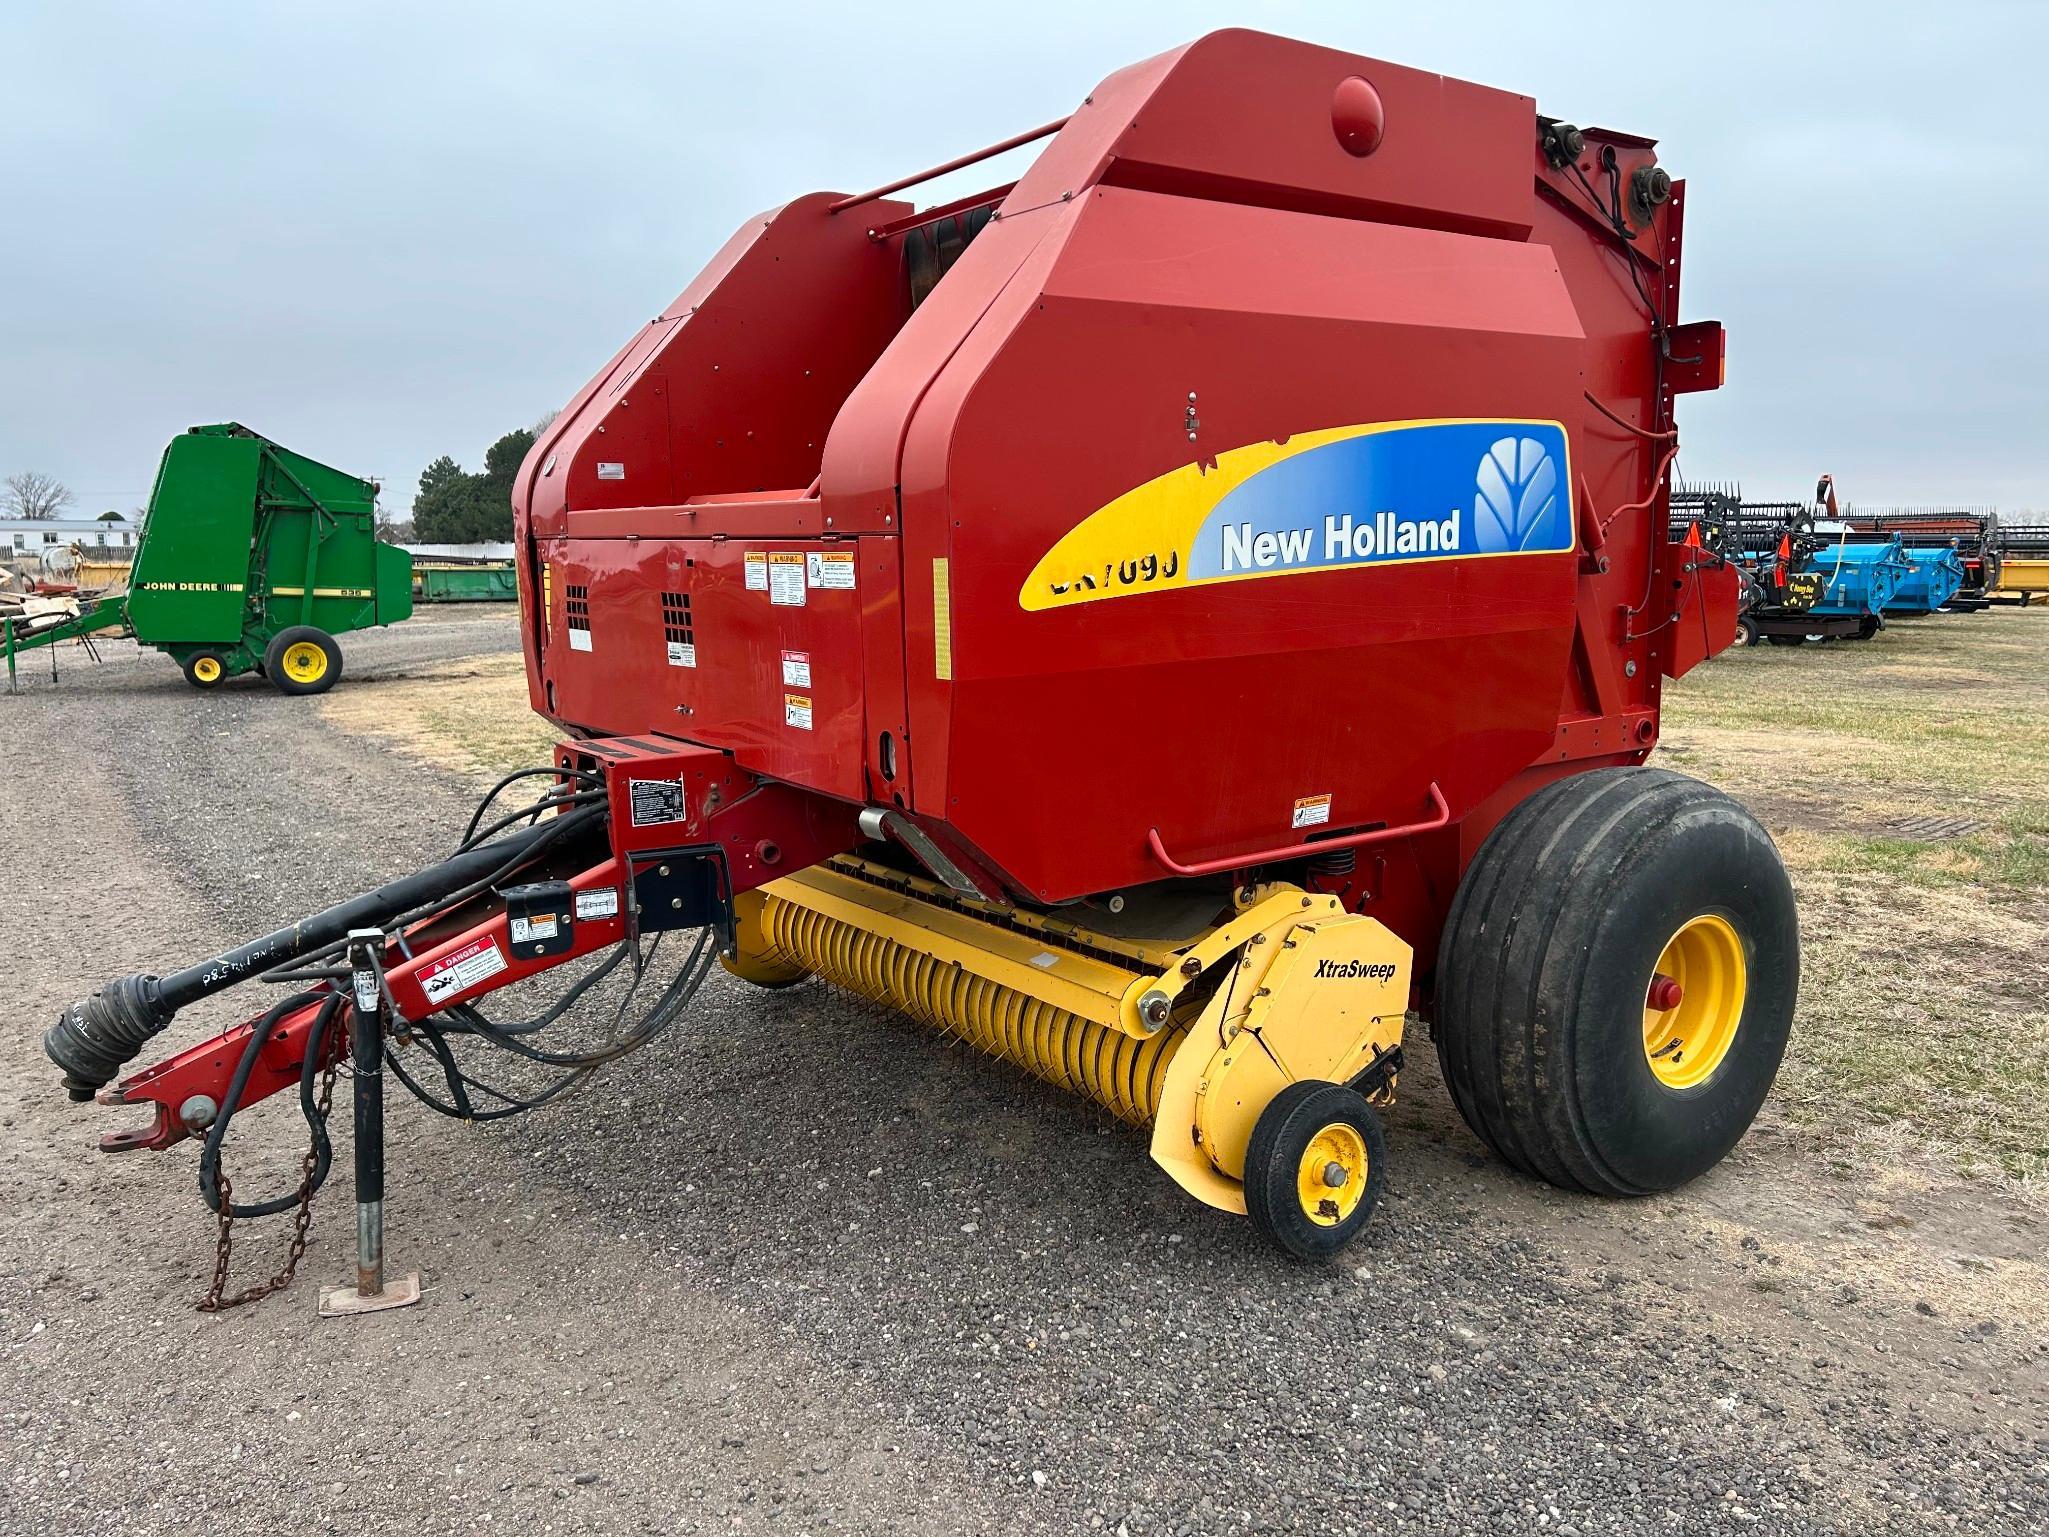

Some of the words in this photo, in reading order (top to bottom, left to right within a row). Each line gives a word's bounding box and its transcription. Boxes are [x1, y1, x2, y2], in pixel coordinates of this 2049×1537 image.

[1222, 522, 1313, 571] New
[1324, 509, 1460, 560] Holland
[143, 582, 176, 591] JOHN
[179, 583, 218, 591] DEERE
[445, 945, 481, 967] DANGER
[1313, 959, 1396, 983] XtraSweep
